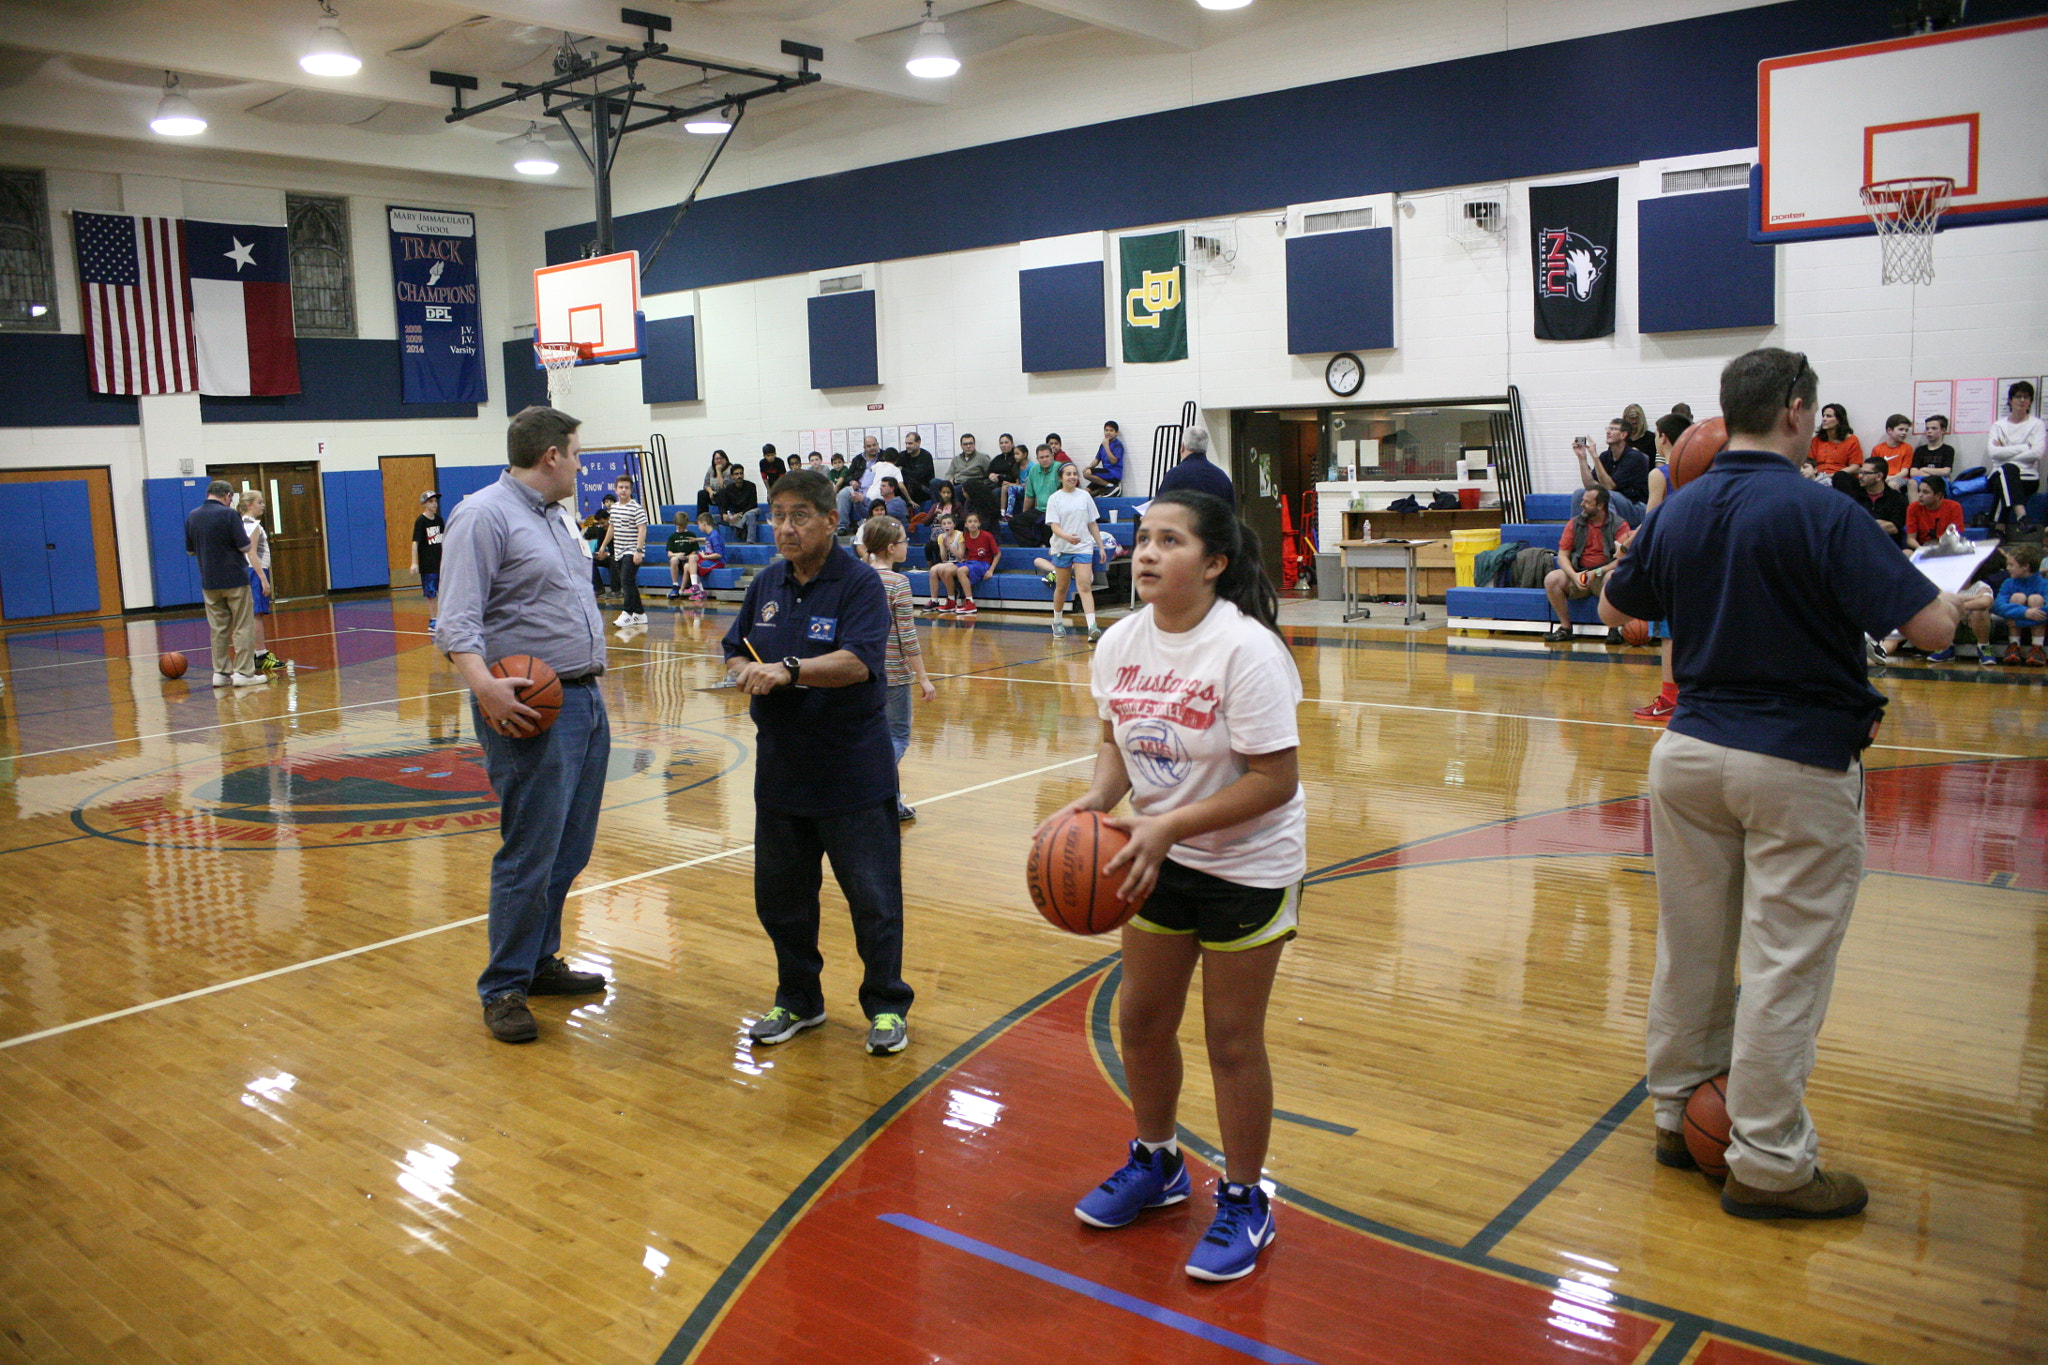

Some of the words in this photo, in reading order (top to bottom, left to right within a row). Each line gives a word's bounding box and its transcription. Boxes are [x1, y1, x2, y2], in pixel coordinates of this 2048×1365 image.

[393, 212, 416, 222] MARY
[419, 213, 471, 225] IMMACULATE
[416, 224, 450, 234] SCHOOL
[400, 237, 464, 265] TRACK
[1547, 232, 1566, 292] NIU
[397, 281, 476, 304] CHAMPIONS
[426, 309, 452, 319] DPL
[461, 326, 474, 335] J.V.
[461, 336, 475, 345] J.V.
[406, 344, 425, 354] 2014
[450, 346, 476, 356] Varsity
[318, 442, 324, 454] F
[590, 462, 604, 471] P.E.
[609, 462, 616, 470] IS
